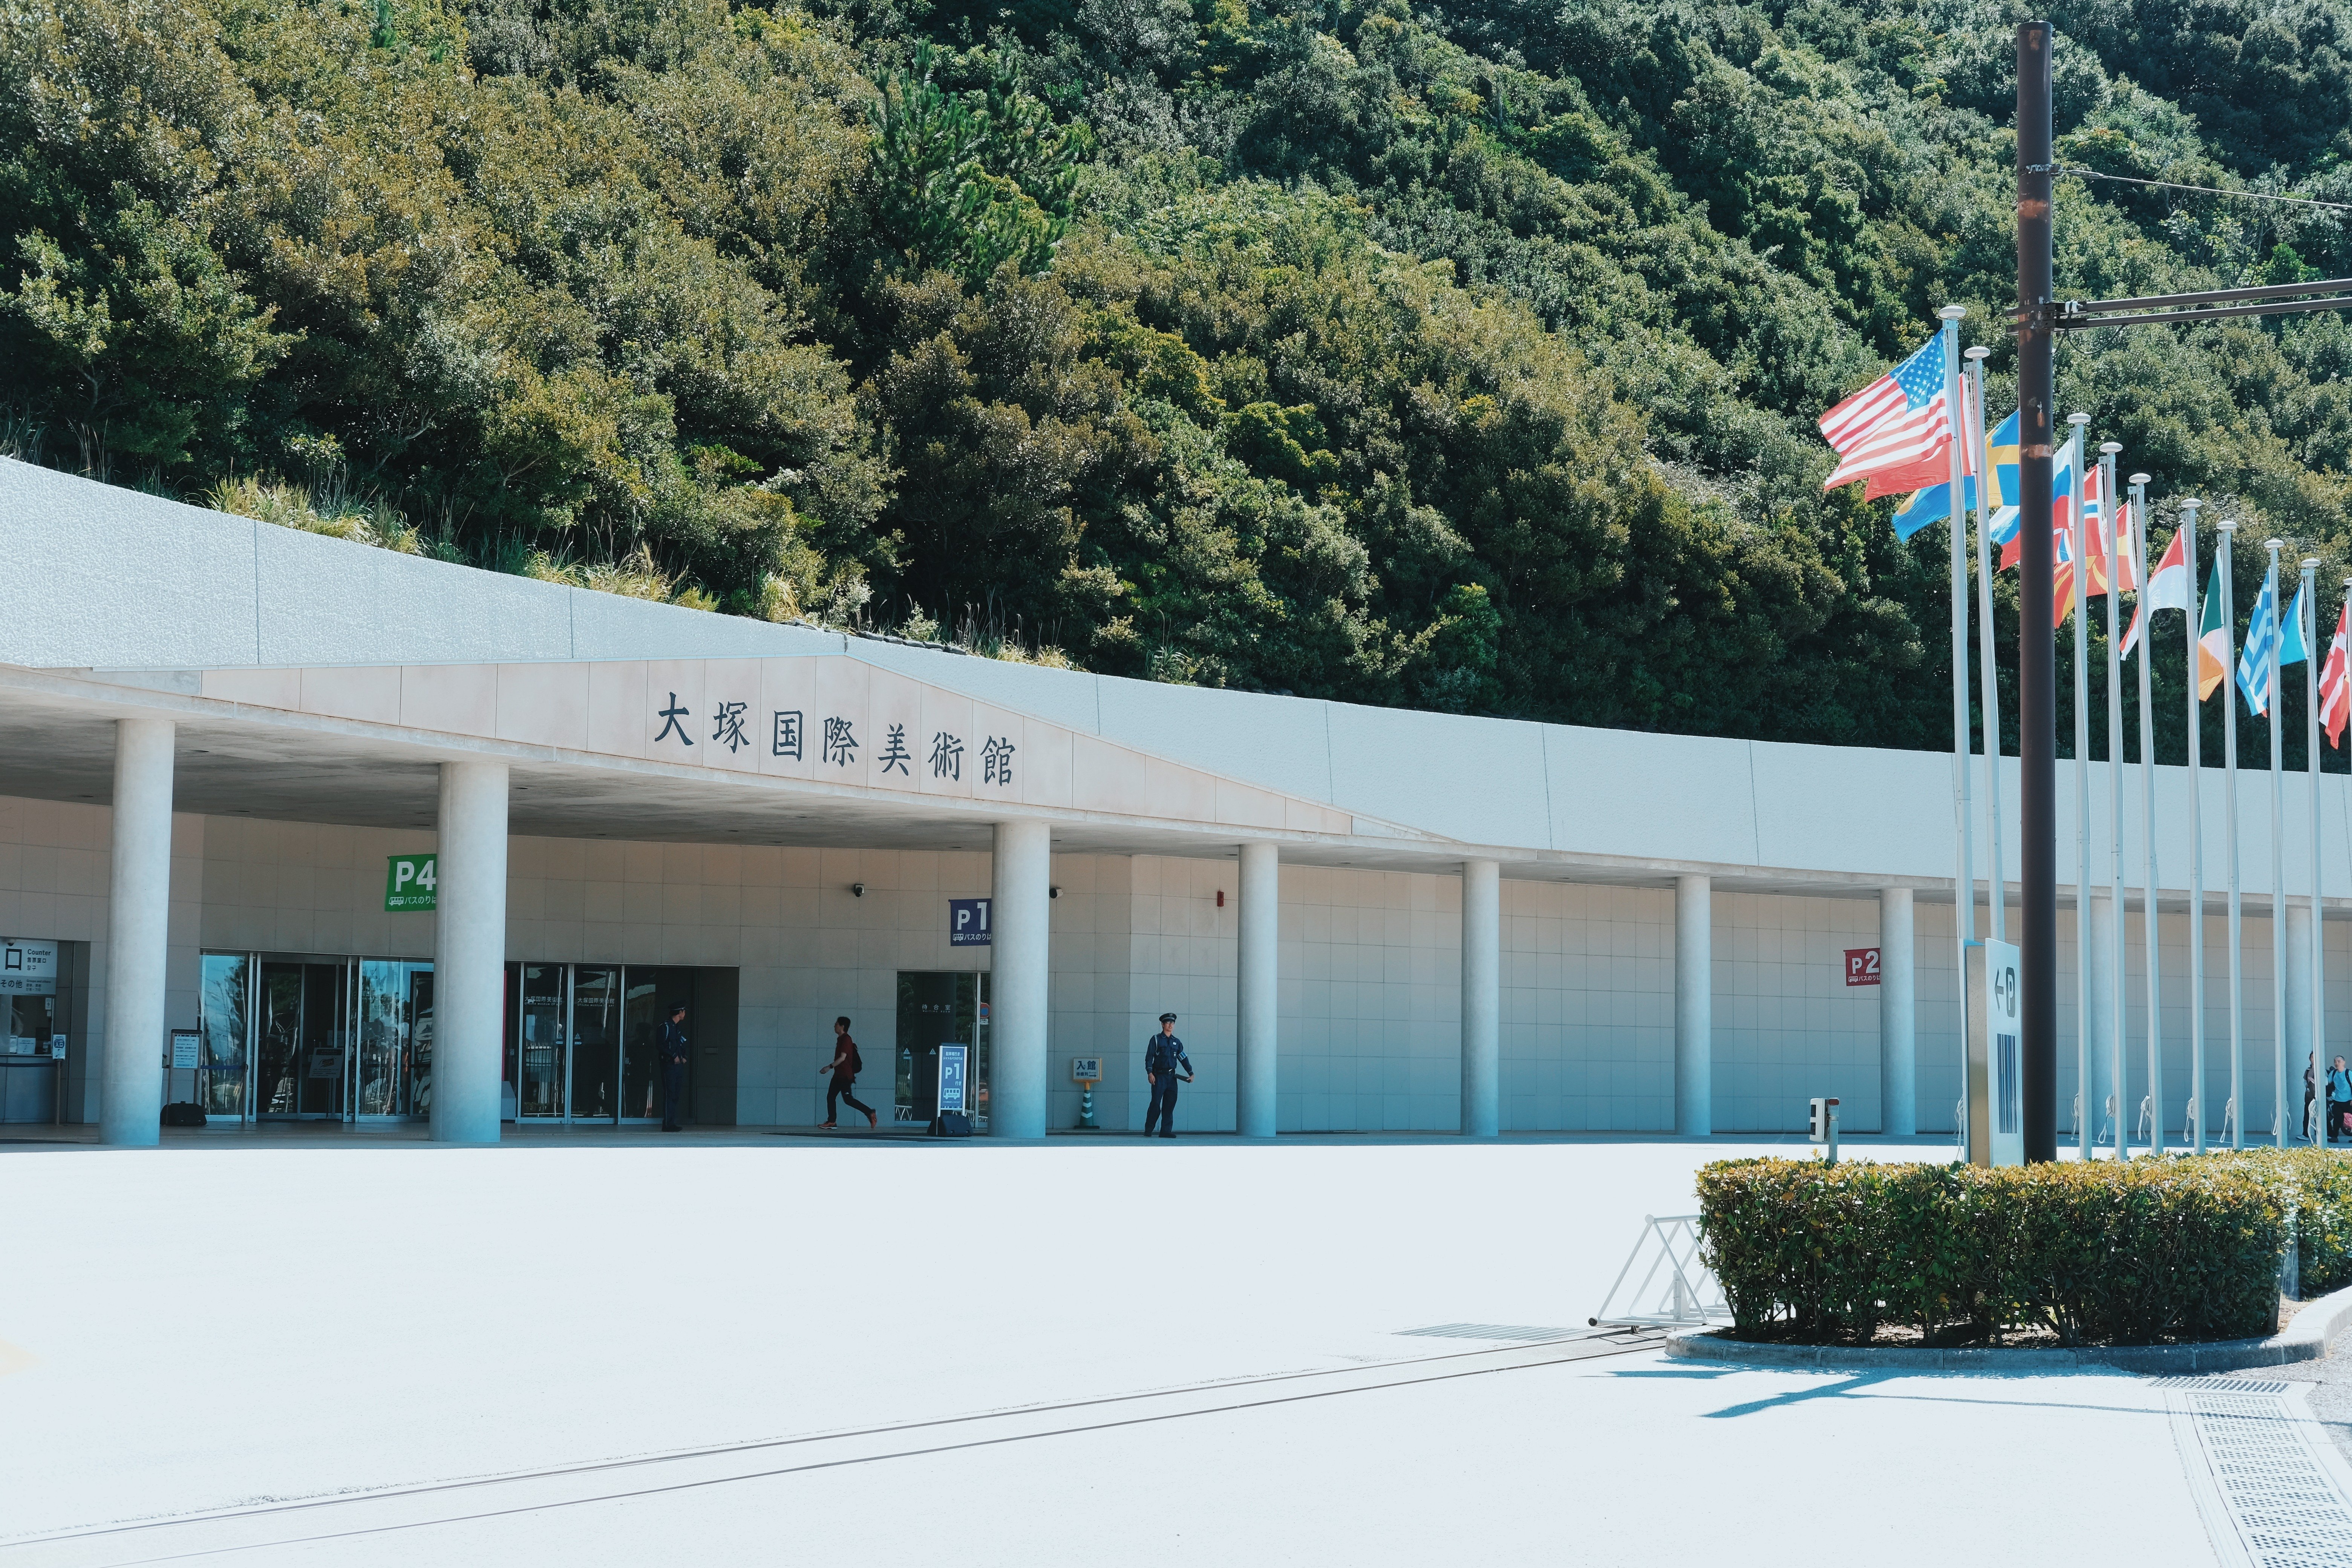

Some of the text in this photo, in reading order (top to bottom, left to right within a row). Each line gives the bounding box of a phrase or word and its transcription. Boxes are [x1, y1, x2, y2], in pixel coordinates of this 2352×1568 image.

[654, 691, 1016, 787] 大塚国際美術館
[395, 860, 436, 892] P4
[957, 902, 987, 930] P1
[1852, 951, 1879, 974] P2
[0, 980, 22, 988] その他
[945, 1063, 960, 1079] P1
[1077, 1061, 1096, 1070] 入館
